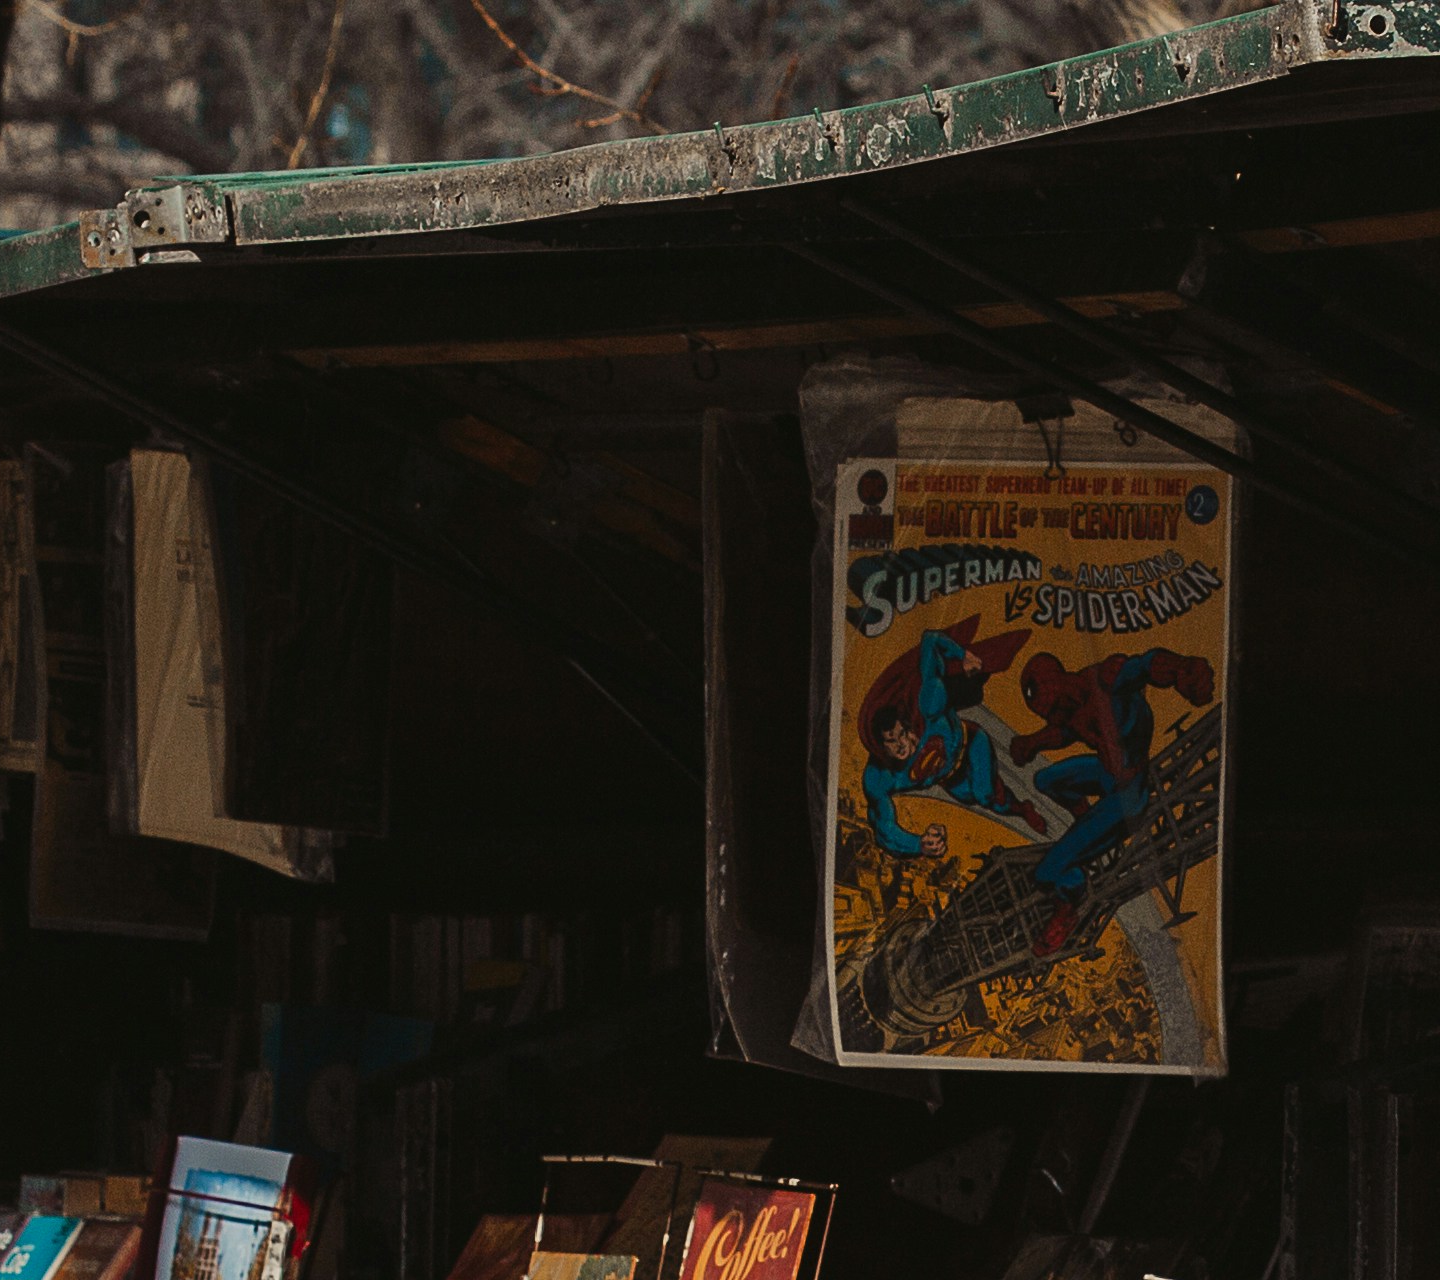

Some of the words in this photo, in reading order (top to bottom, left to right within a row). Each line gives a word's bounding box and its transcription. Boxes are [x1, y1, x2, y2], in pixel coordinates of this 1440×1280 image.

[918, 475, 980, 494] GREATEST
[985, 476, 1049, 494] SUPERHERO
[1057, 476, 1107, 494] TEAM-UP
[1111, 477, 1125, 494] OF
[1131, 476, 1150, 495] ALL
[1154, 476, 1187, 495] TIME!
[898, 506, 924, 526] THE
[925, 500, 1017, 538] BATTLE
[1020, 509, 1038, 527] OF
[1043, 508, 1069, 527] THE
[1070, 502, 1182, 540] CENTURY
[1076, 549, 1185, 588] AMAZING
[860, 557, 1042, 637] SUPERMAN
[1033, 561, 1221, 633] SPIDER-MAN
